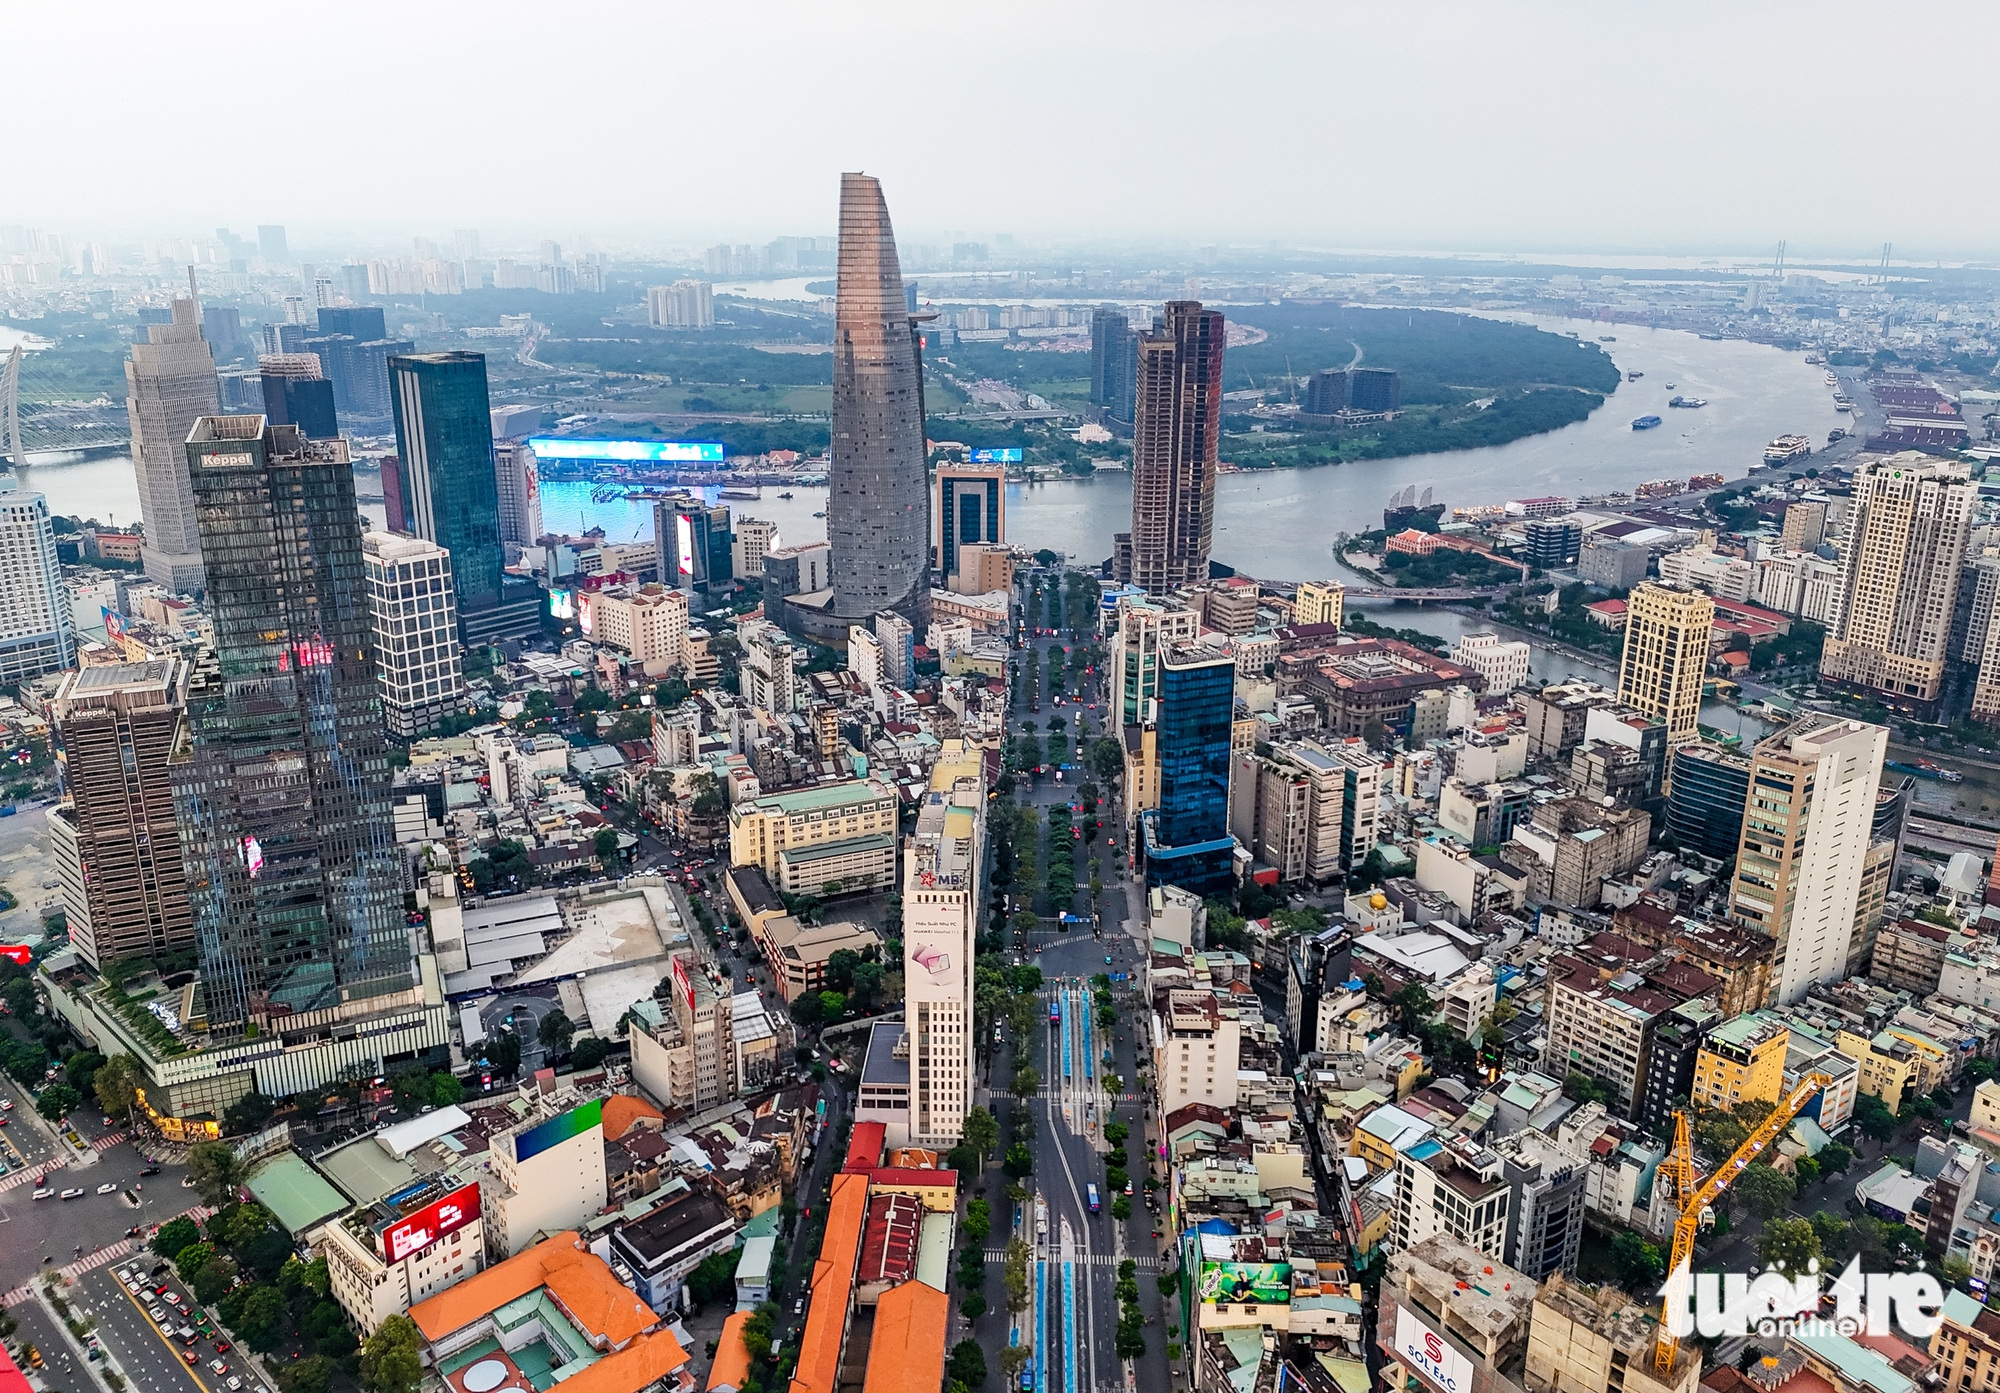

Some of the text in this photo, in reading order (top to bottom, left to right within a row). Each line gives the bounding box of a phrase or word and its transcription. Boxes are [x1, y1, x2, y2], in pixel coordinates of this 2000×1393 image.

[203, 453, 251, 466] Keppel
[75, 708, 106, 717] Keppel
[938, 875, 960, 885] MB
[1408, 1345, 1430, 1371] SOL
[1433, 1365, 1457, 1391] E&C
